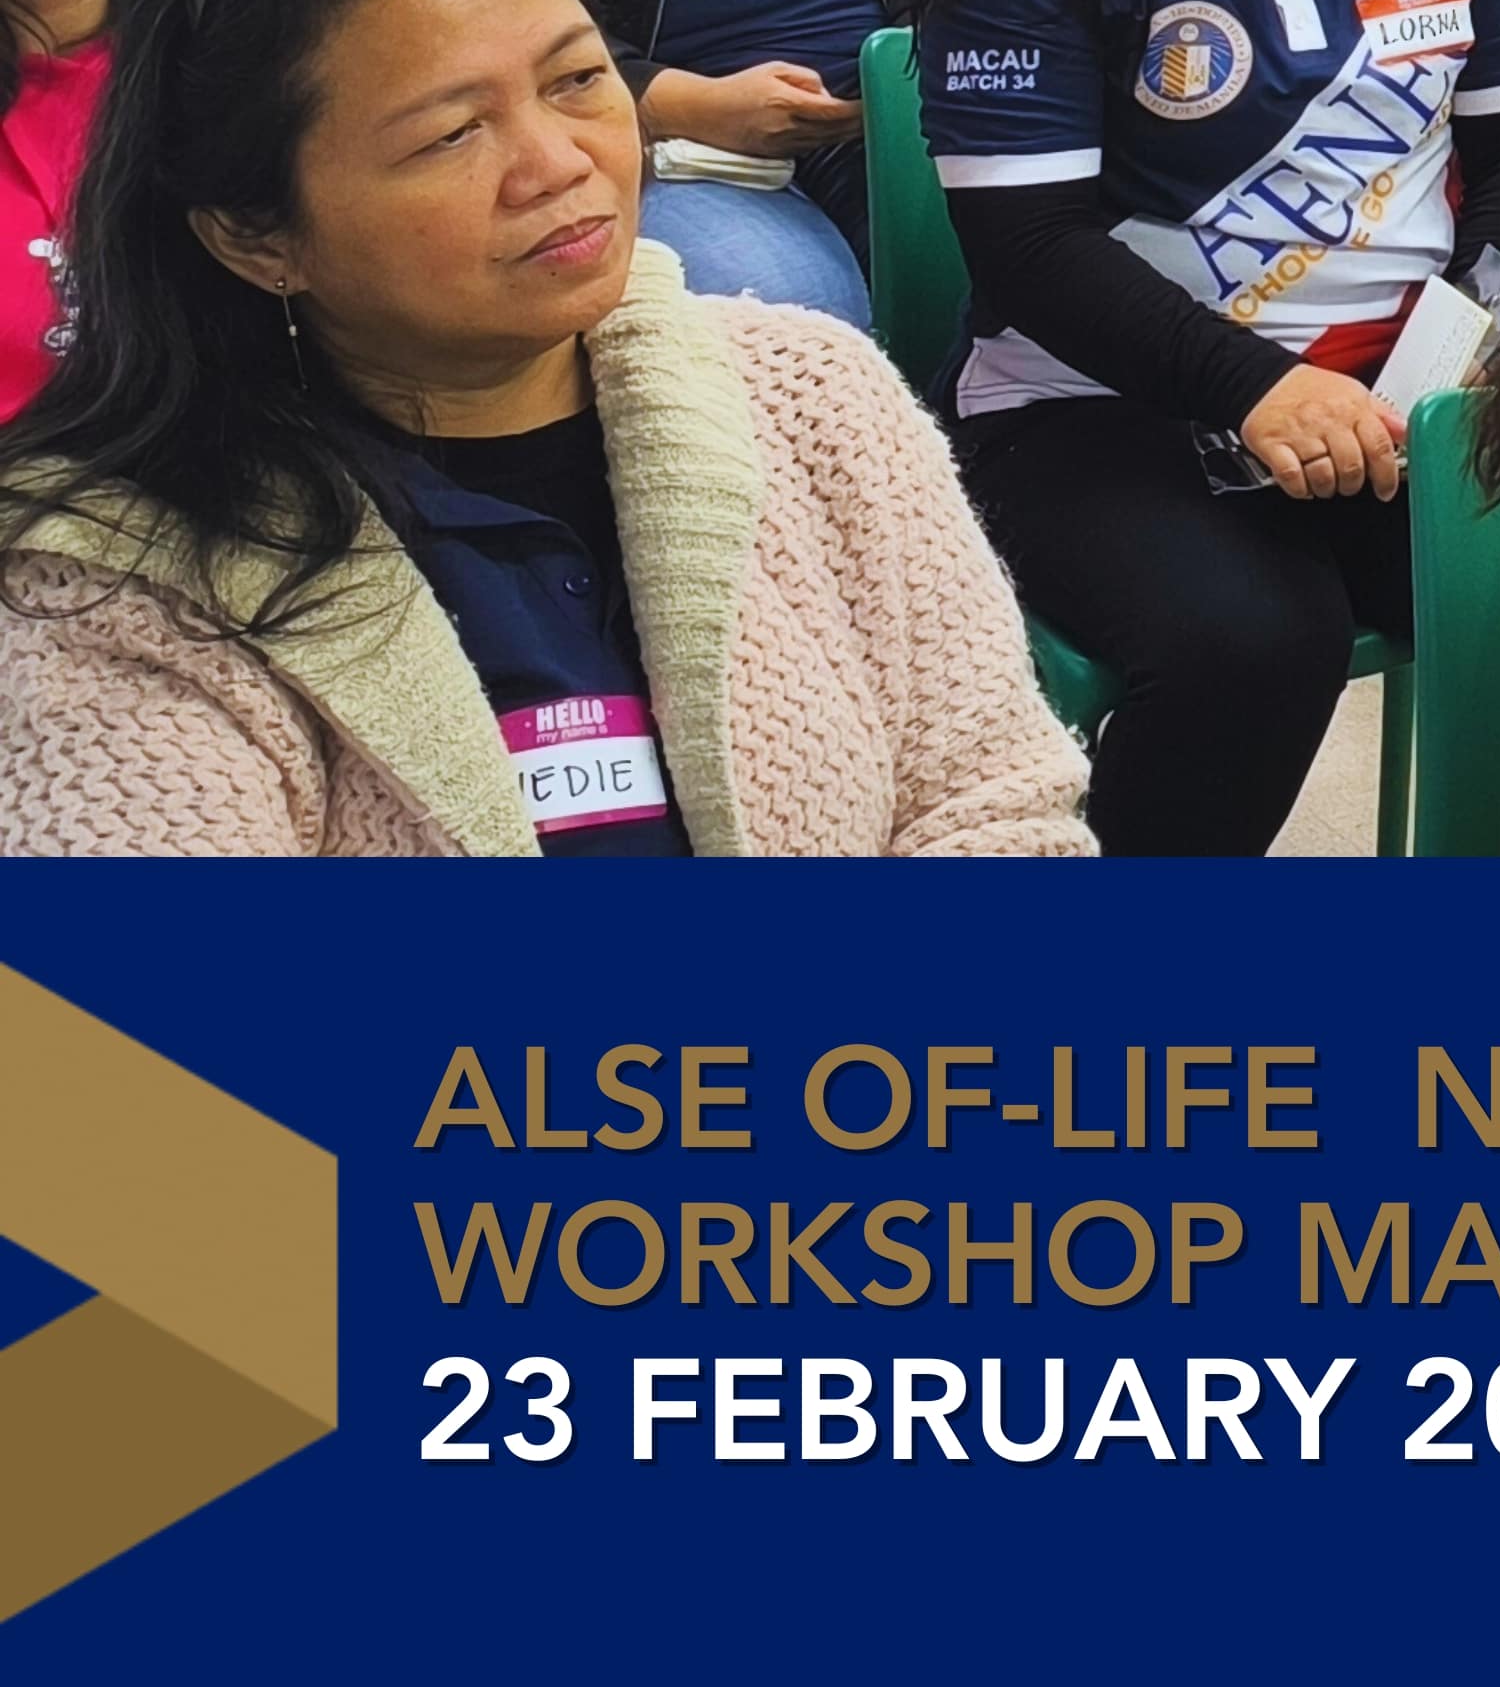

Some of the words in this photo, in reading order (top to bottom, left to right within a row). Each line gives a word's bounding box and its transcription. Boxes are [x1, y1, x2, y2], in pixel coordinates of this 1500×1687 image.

[1379, 9, 1460, 45] LORNA
[946, 49, 1041, 73] MACAU
[946, 74, 1007, 91] BATCH
[1012, 73, 1036, 90] 34
[536, 699, 606, 733] HELLO
